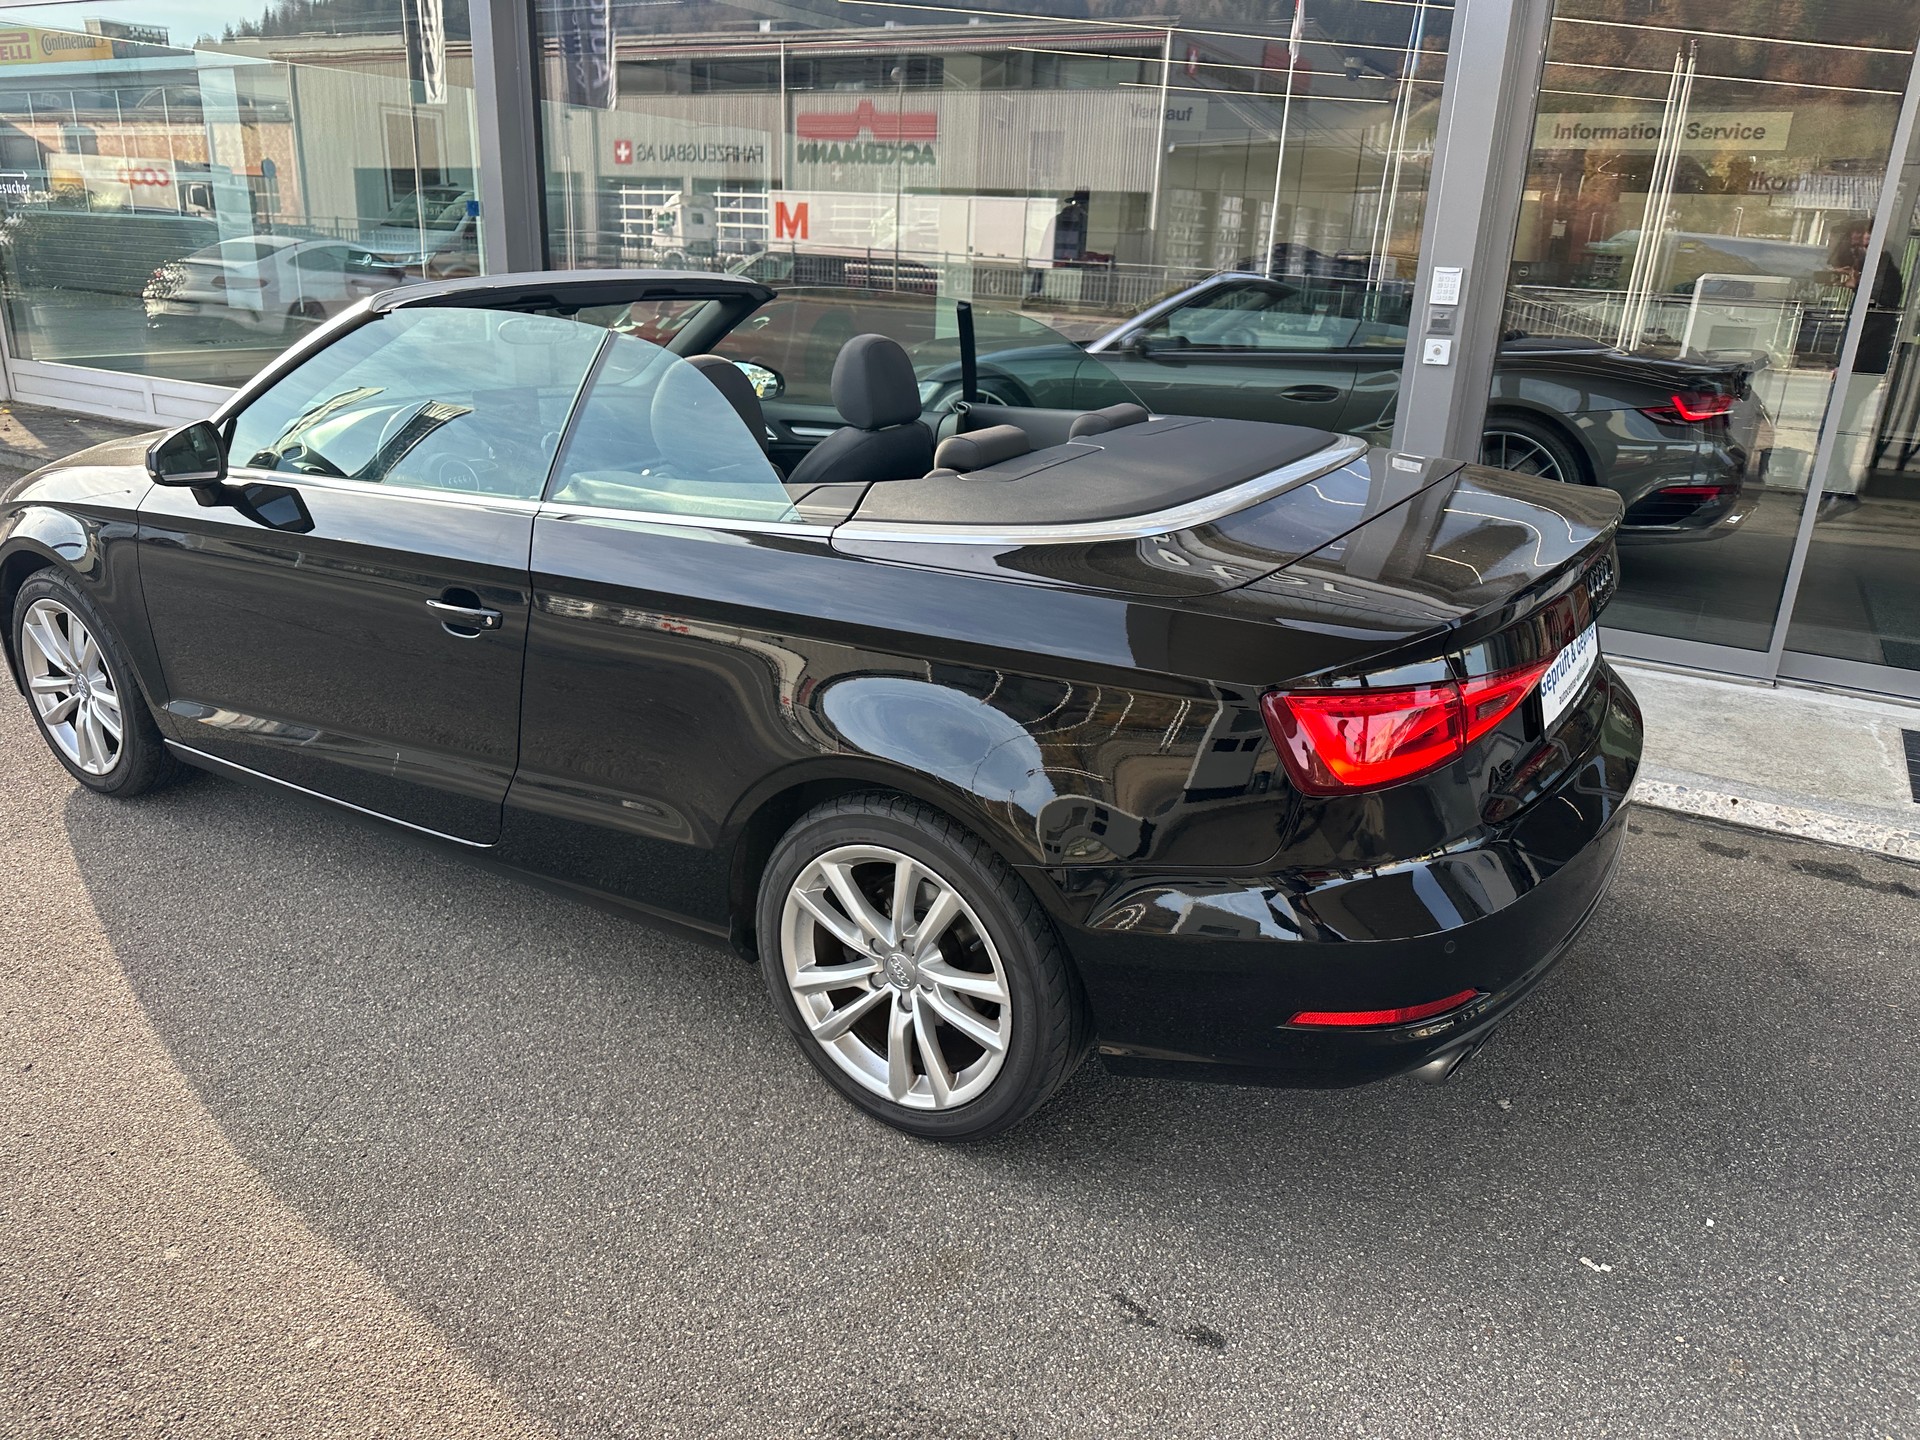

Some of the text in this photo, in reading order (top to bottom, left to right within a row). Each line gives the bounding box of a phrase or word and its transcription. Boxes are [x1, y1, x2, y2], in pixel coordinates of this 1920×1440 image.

[41, 33, 97, 56] Continental
[1554, 122, 1766, 140] Information Service
[775, 201, 809, 240] M
